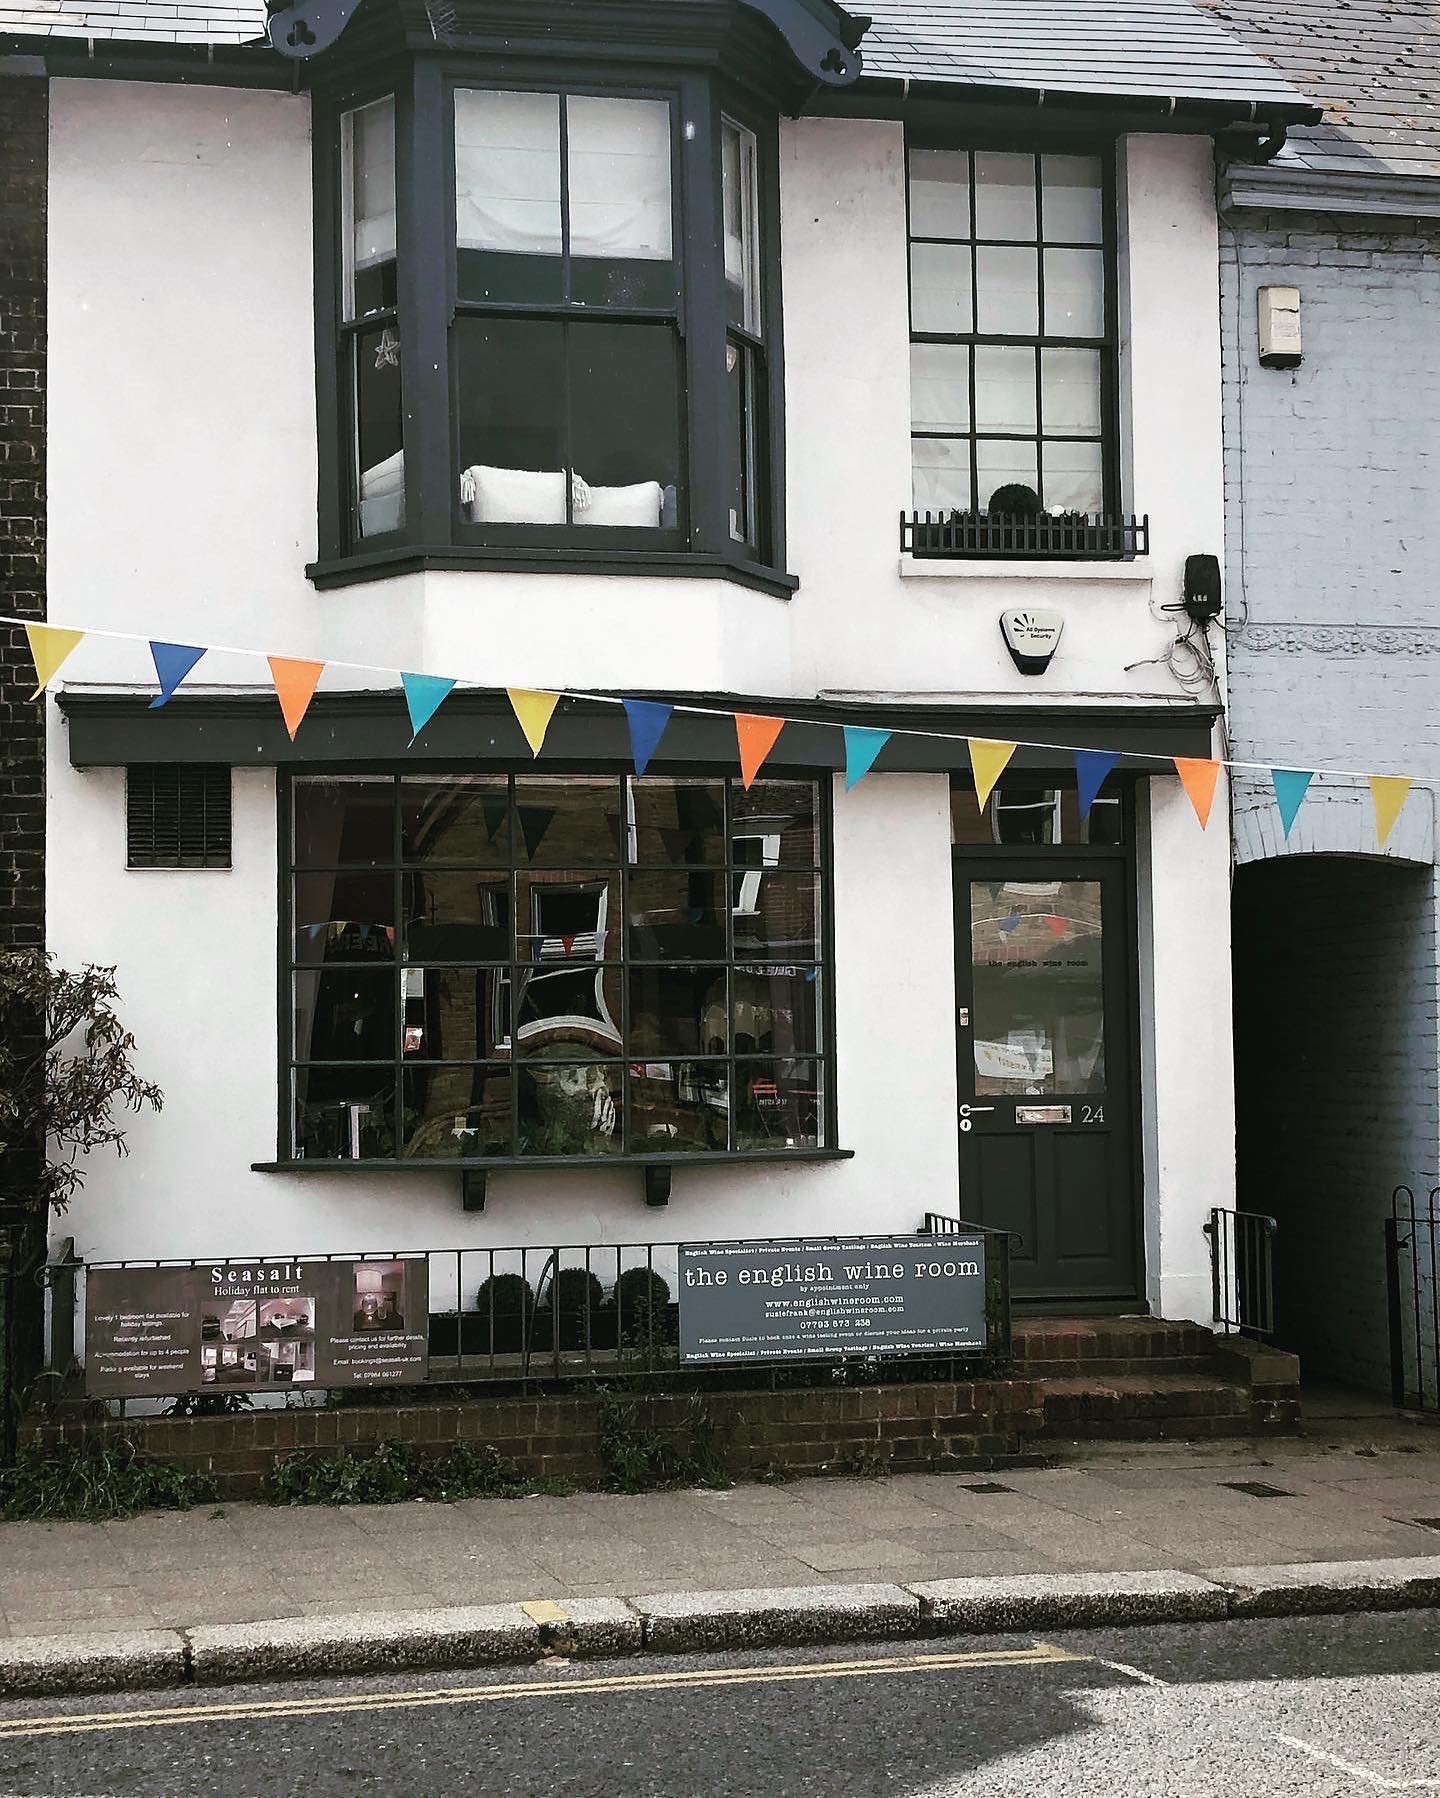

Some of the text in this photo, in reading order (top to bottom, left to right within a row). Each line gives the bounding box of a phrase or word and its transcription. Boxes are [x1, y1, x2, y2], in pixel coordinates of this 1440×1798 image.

[1007, 960, 1038, 968] english
[1081, 1105, 1104, 1123] 24
[212, 1264, 303, 1283] Seasalt
[684, 1260, 980, 1287] the english wine room
[214, 1286, 250, 1296] Holiday
[253, 1285, 268, 1294] flat
[282, 1286, 300, 1294] rent
[810, 1284, 852, 1292] appointment
[765, 1295, 904, 1308] www.englishwineroom.com
